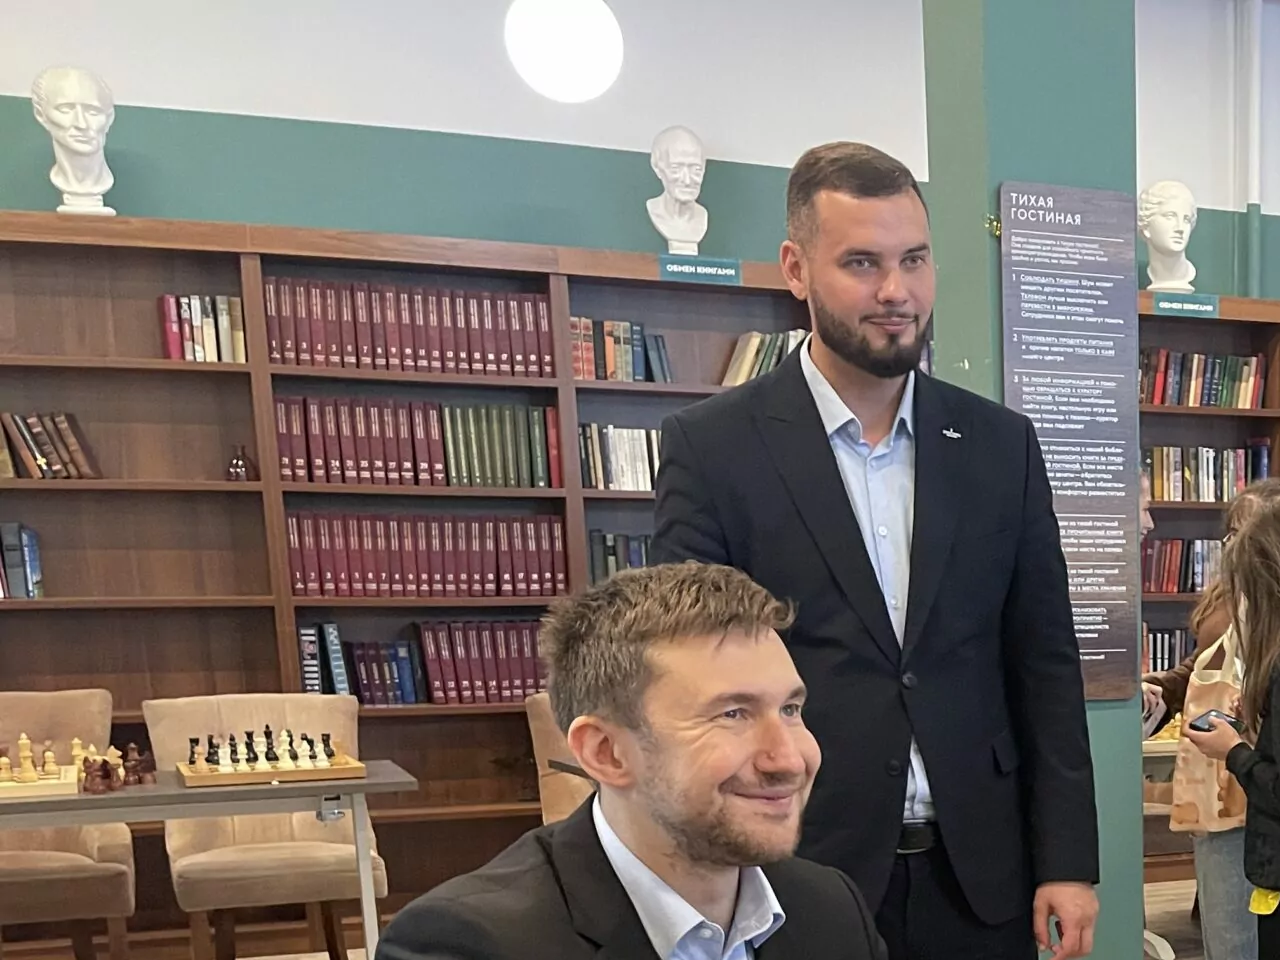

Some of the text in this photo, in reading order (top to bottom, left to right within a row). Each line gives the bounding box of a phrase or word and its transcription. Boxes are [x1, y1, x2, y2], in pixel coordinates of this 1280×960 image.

[1010, 193, 1054, 209] ТИХАЯ
[1011, 207, 1081, 225] ГОСТИНАЯ
[666, 264, 736, 276] ОБМЕН КНИГАМИ
